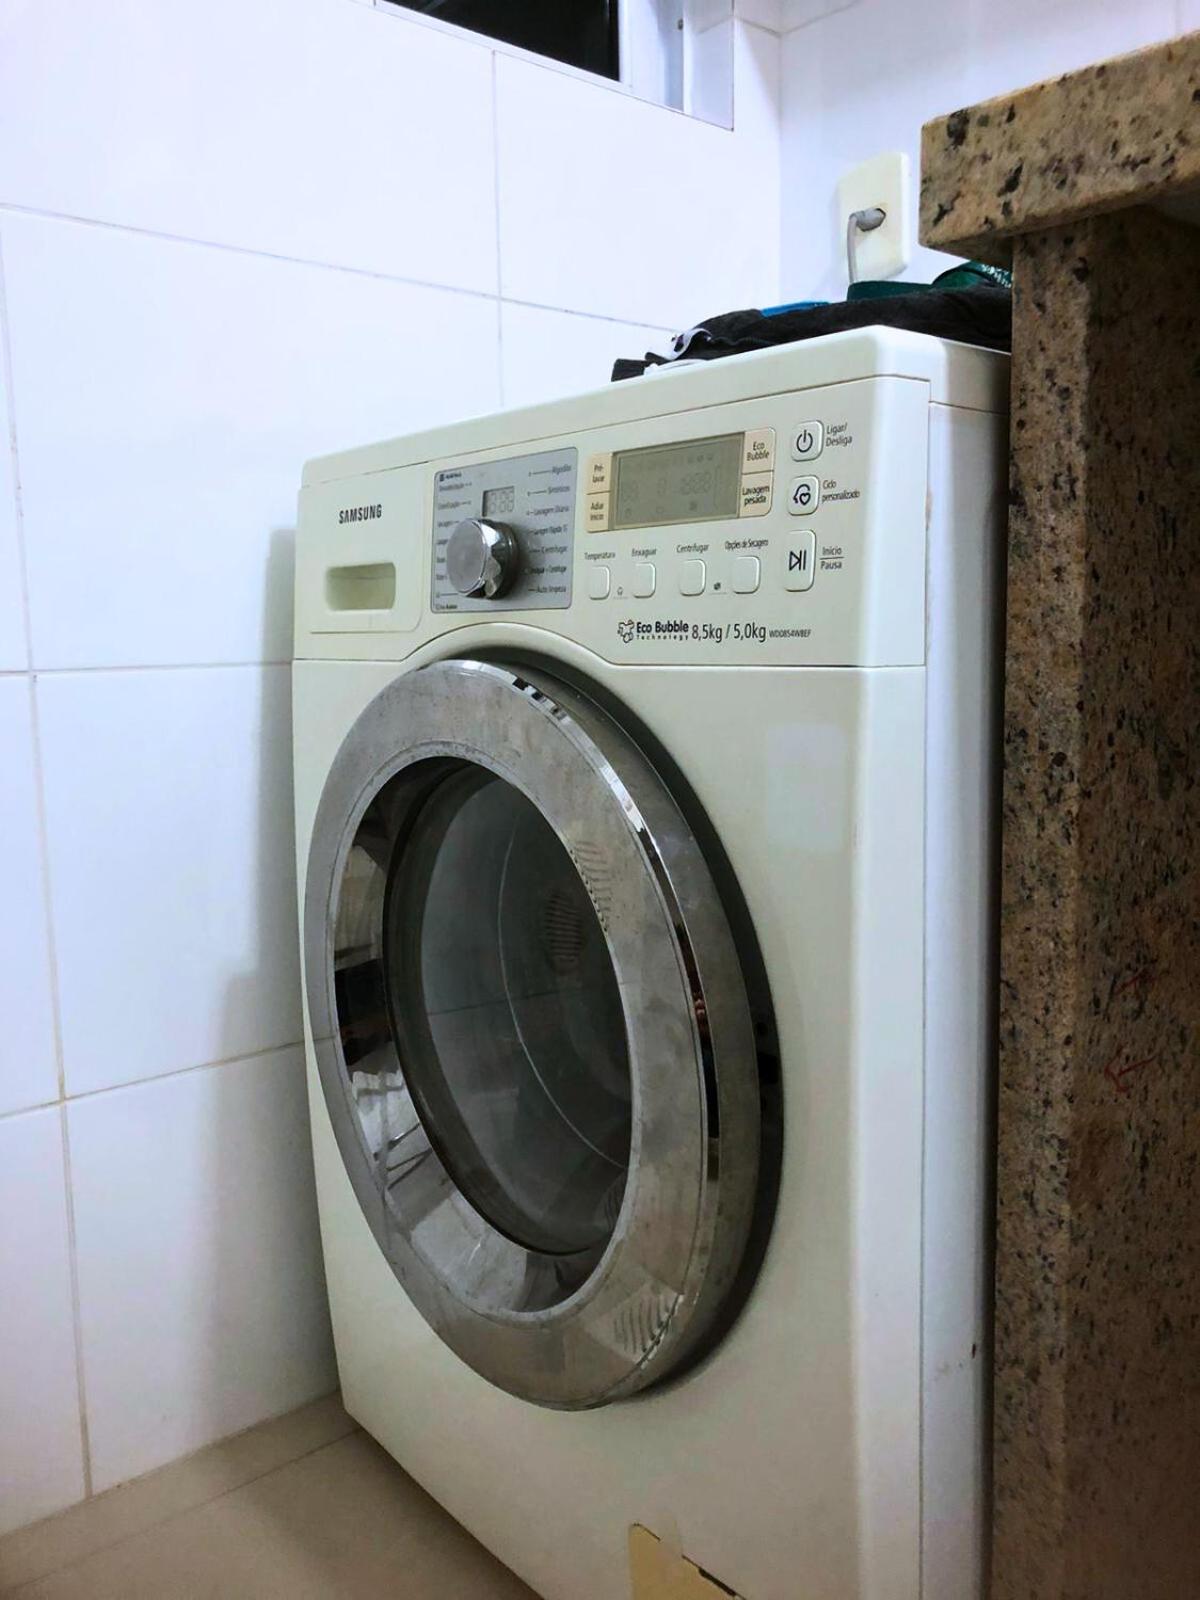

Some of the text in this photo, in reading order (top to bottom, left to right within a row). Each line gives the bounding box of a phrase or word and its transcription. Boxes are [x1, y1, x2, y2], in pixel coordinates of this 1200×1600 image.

[752, 441, 765, 451] Eco
[825, 435, 853, 447] Desliga
[746, 450, 769, 462] Bubble
[742, 485, 770, 496] Lavagem
[822, 479, 837, 490] Ciclo
[744, 495, 767, 507] pesada
[821, 489, 861, 503] personalizado
[339, 503, 383, 524] SAMSUNG
[676, 543, 710, 554] Centrifugar
[820, 560, 842, 570] Pausa
[636, 620, 689, 634] Eco Bubble
[692, 623, 723, 643] 8,5kg
[733, 622, 767, 643] 5,0kg
